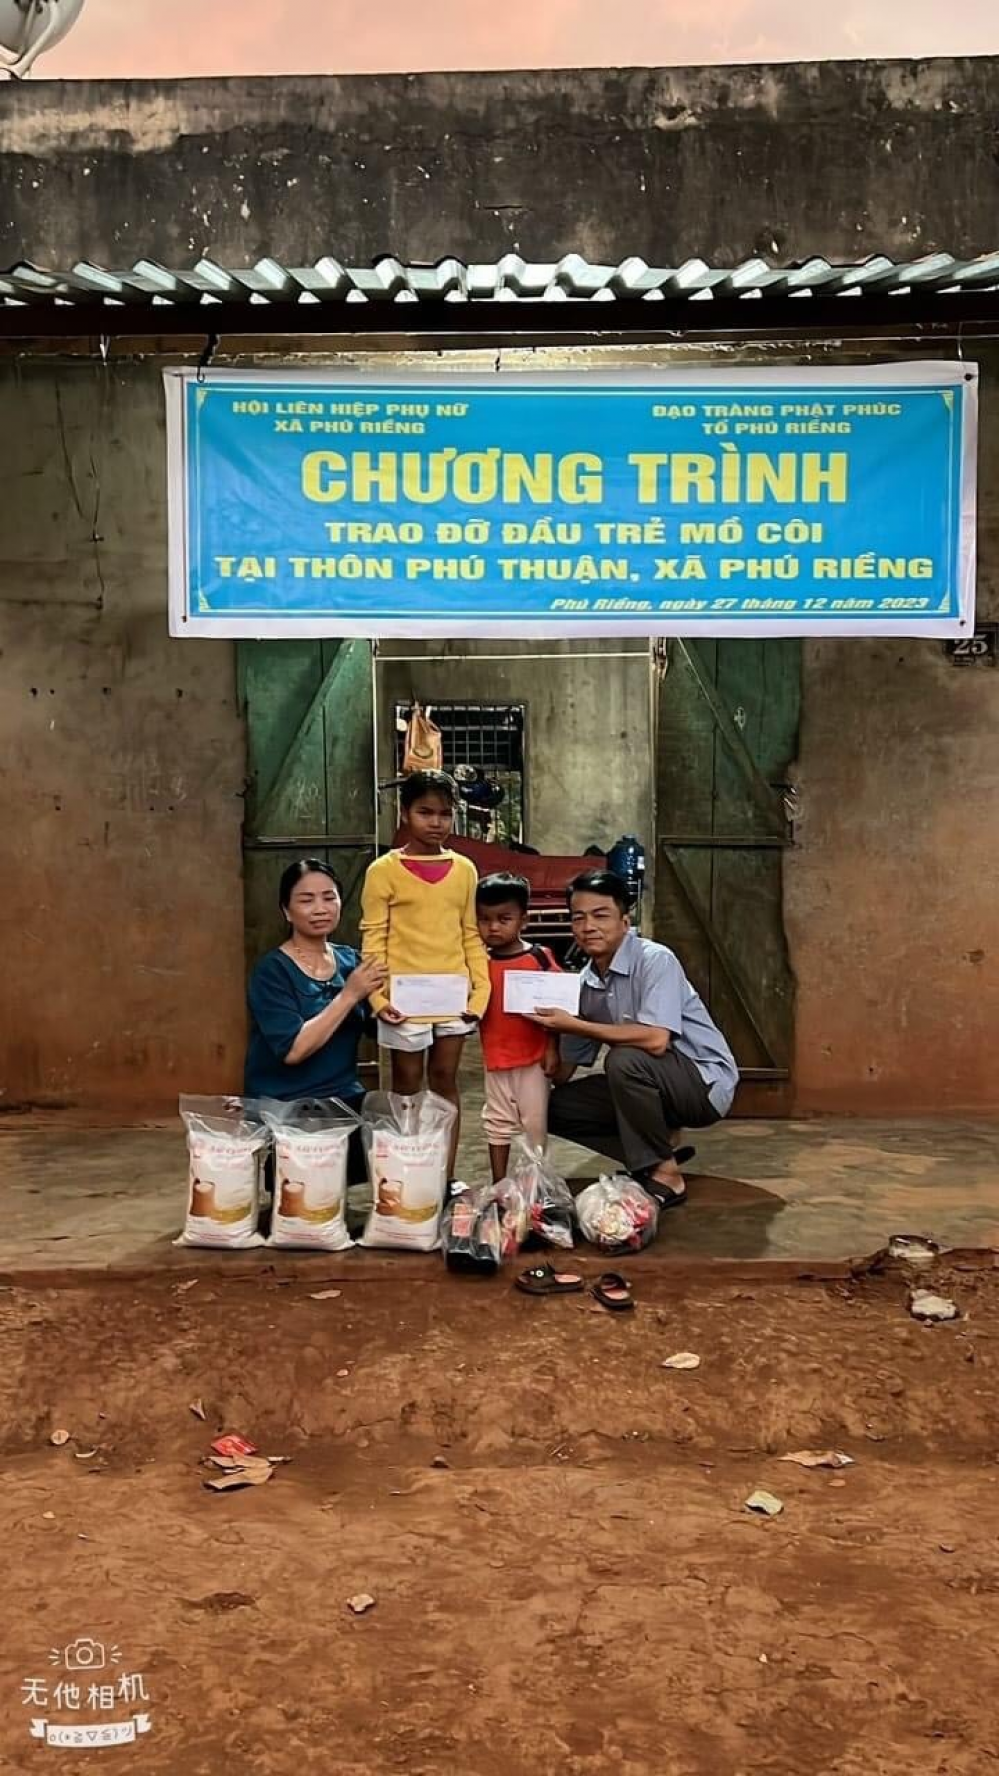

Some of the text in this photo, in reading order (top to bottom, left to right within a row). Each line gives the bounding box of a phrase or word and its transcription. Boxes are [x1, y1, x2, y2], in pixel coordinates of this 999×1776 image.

[233, 399, 470, 419] HỘI LIÊN HIỆP PHỤ NỮ
[652, 404, 696, 420] ĐẠO
[701, 402, 774, 417] TRÀNG
[780, 402, 837, 419] PHẬT
[273, 418, 426, 434] XÃ PHÚ RIỀNG
[735, 420, 778, 434] PHÚ
[784, 418, 852, 434] RIỀNG
[301, 442, 849, 505] CHƯƠNG TRÌNH
[324, 515, 823, 545] TRAO ĐỠ ĐẦU TRẺ MỒ CÔI
[214, 551, 934, 585] TẠI THÔN PHÚ THUẬN, XÃ PHÚ RIỀNG
[550, 597, 589, 611] Phú
[658, 597, 709, 611] ngày
[710, 597, 739, 610] 27
[741, 597, 798, 611] tháng
[802, 597, 829, 610] 12
[831, 597, 875, 610] năm
[877, 596, 930, 610] 2023
[953, 634, 989, 655] 25
